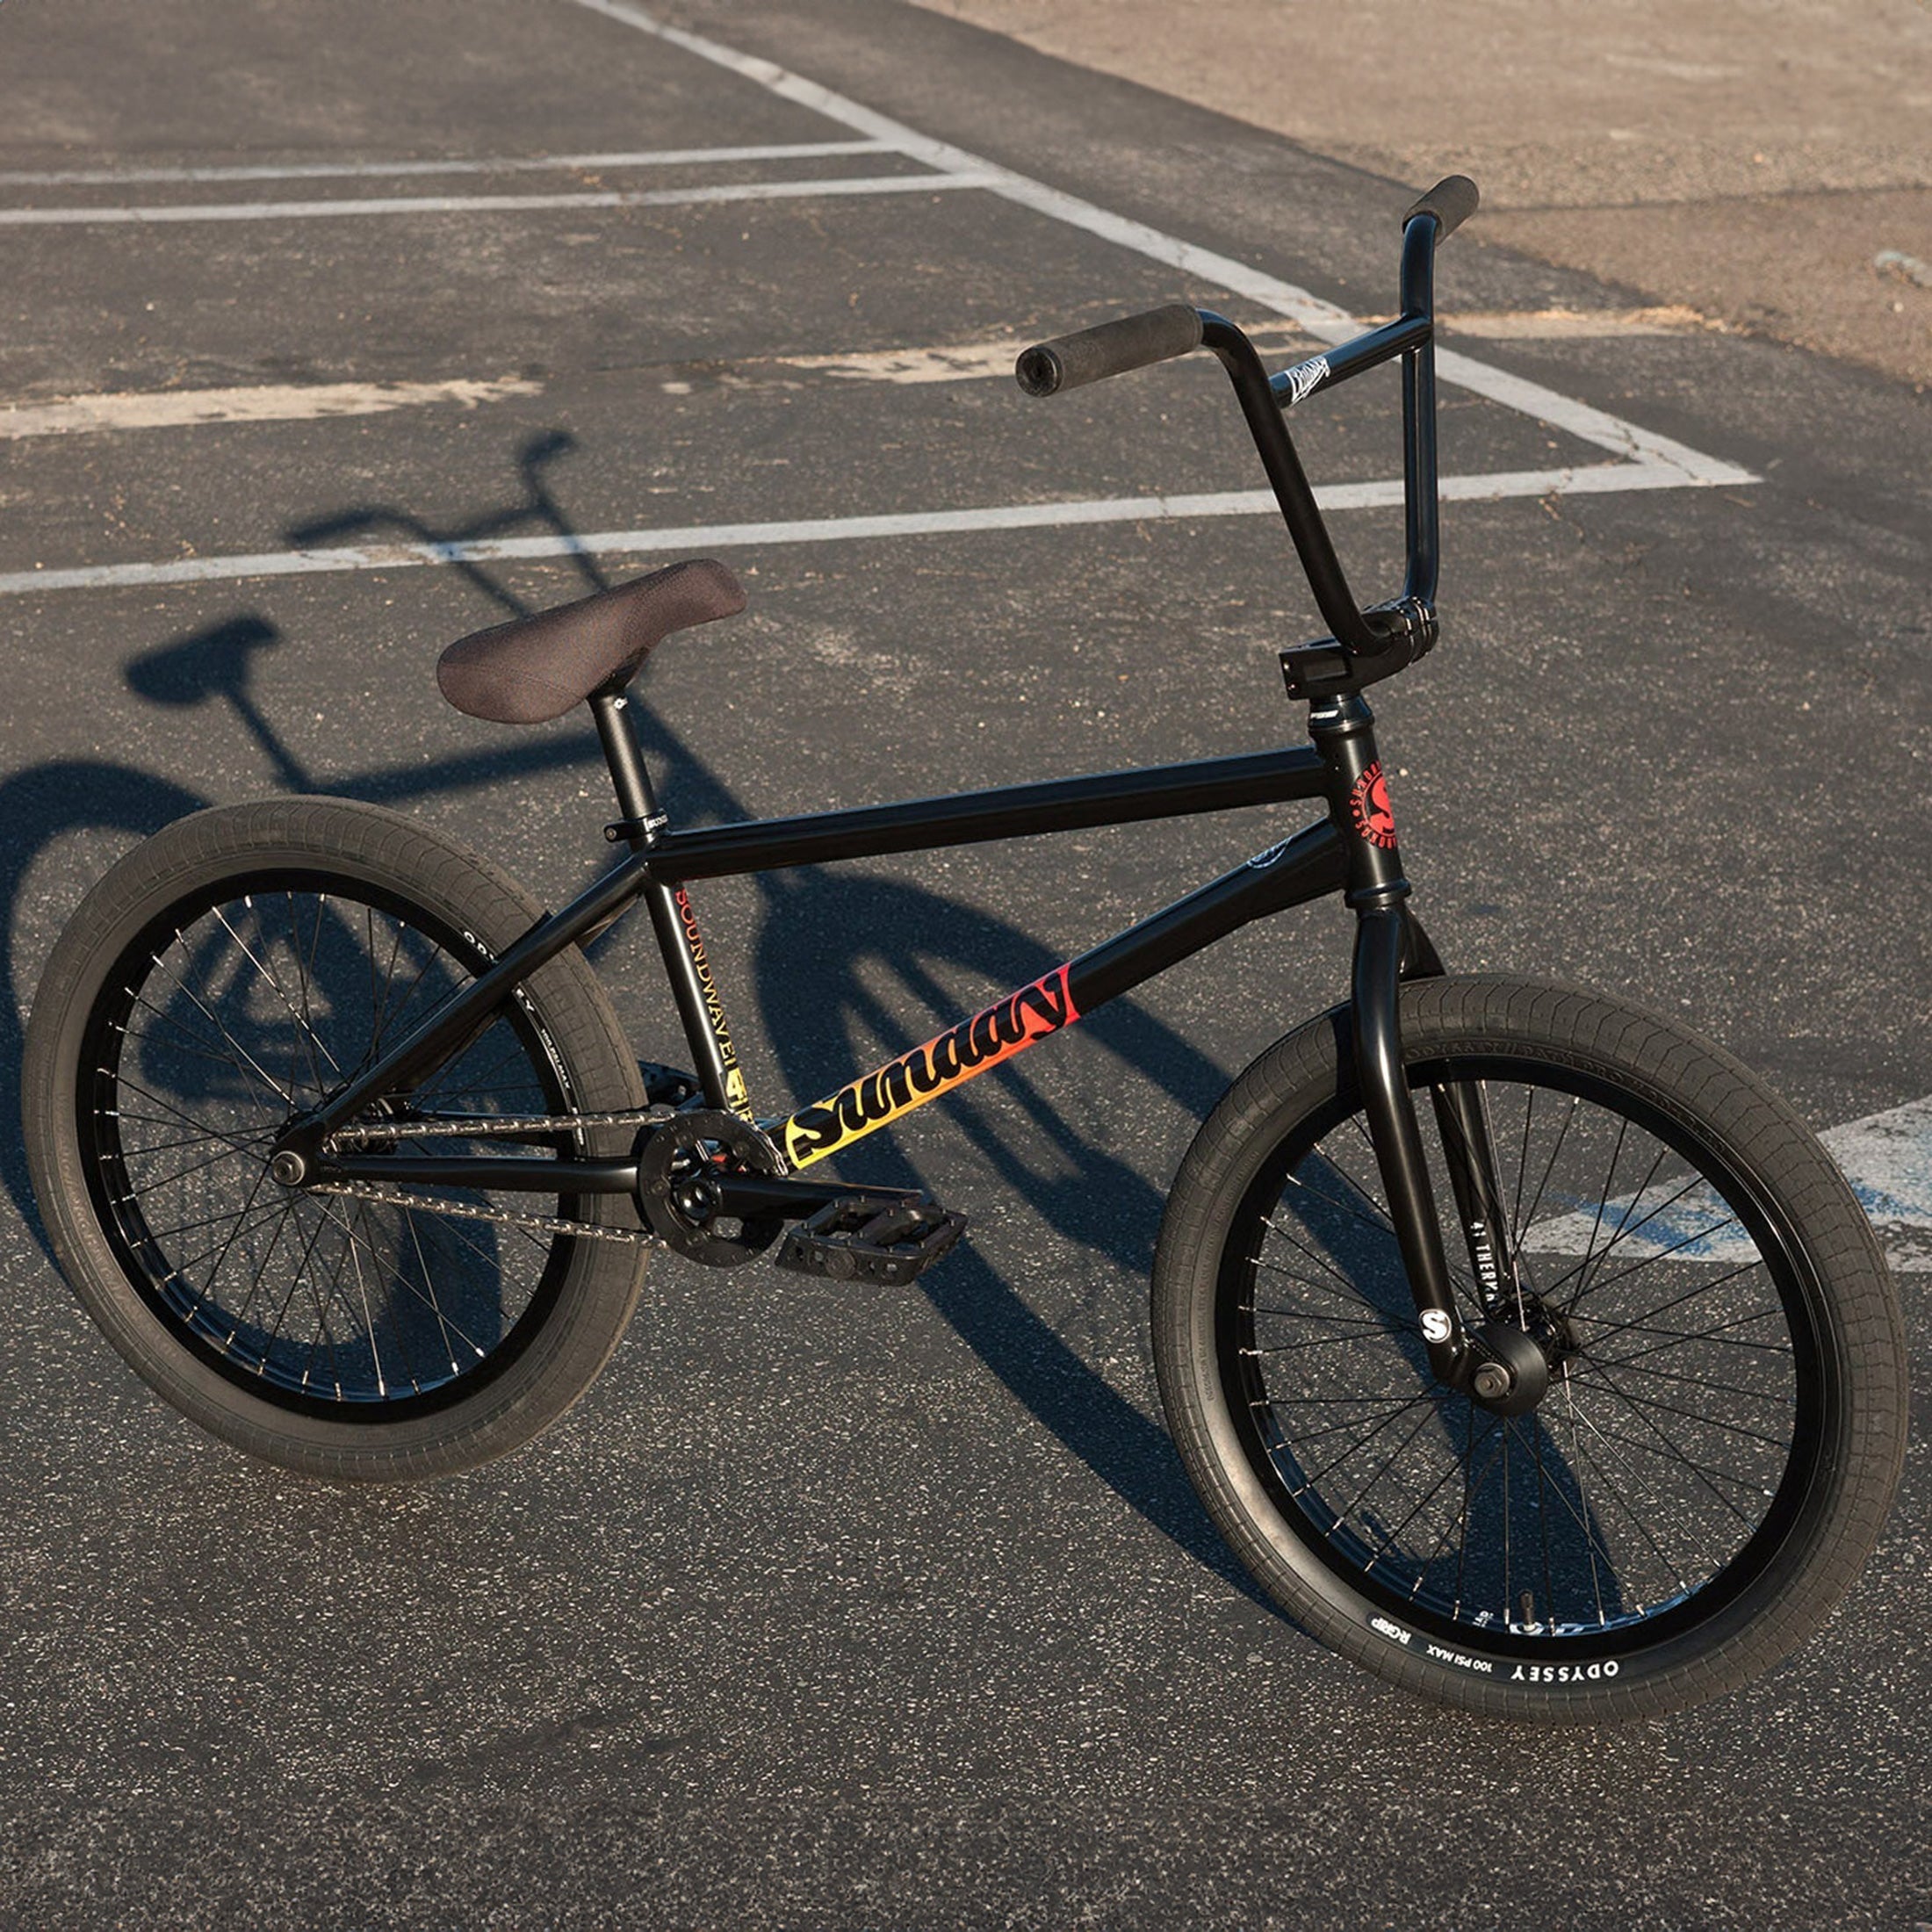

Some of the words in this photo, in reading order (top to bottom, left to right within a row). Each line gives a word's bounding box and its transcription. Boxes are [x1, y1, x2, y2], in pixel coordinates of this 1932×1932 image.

[1350, 761, 1381, 807] SUND
[1355, 819, 1396, 849] SUND
[675, 888, 736, 1060] SOUNDWAVE
[1426, 1643, 1454, 1664] MAX
[1454, 1654, 1472, 1669] PSI
[1473, 1659, 1492, 1673] 100
[1510, 1660, 1619, 1683] ODYSSEY
